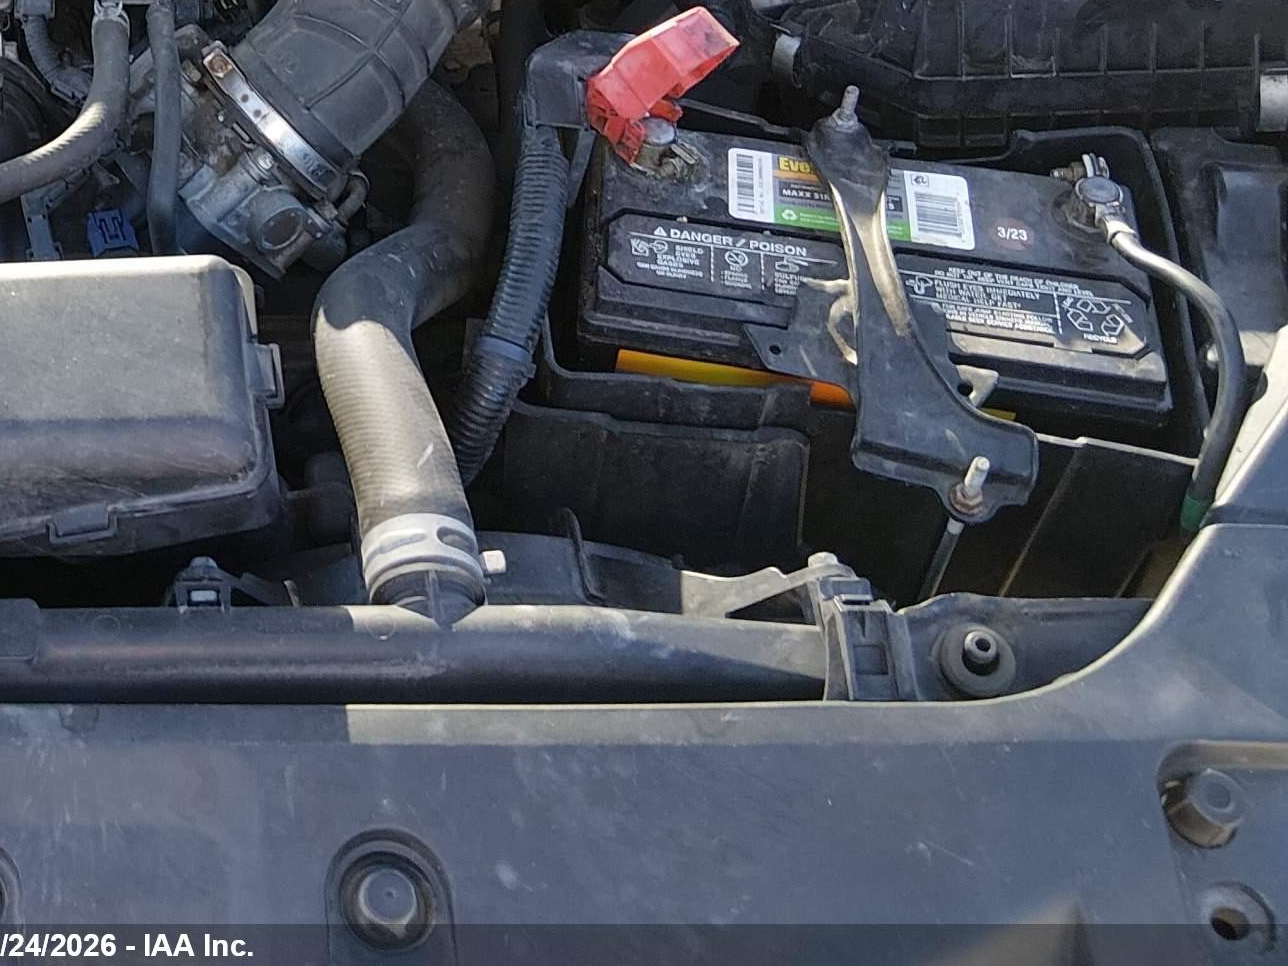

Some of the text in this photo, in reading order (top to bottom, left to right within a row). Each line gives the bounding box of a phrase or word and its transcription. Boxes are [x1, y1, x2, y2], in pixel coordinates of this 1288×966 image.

[782, 188, 811, 198] MAXX
[996, 227, 1028, 241] 3/23
[670, 228, 733, 247] DANGER
[750, 240, 808, 257] POISON
